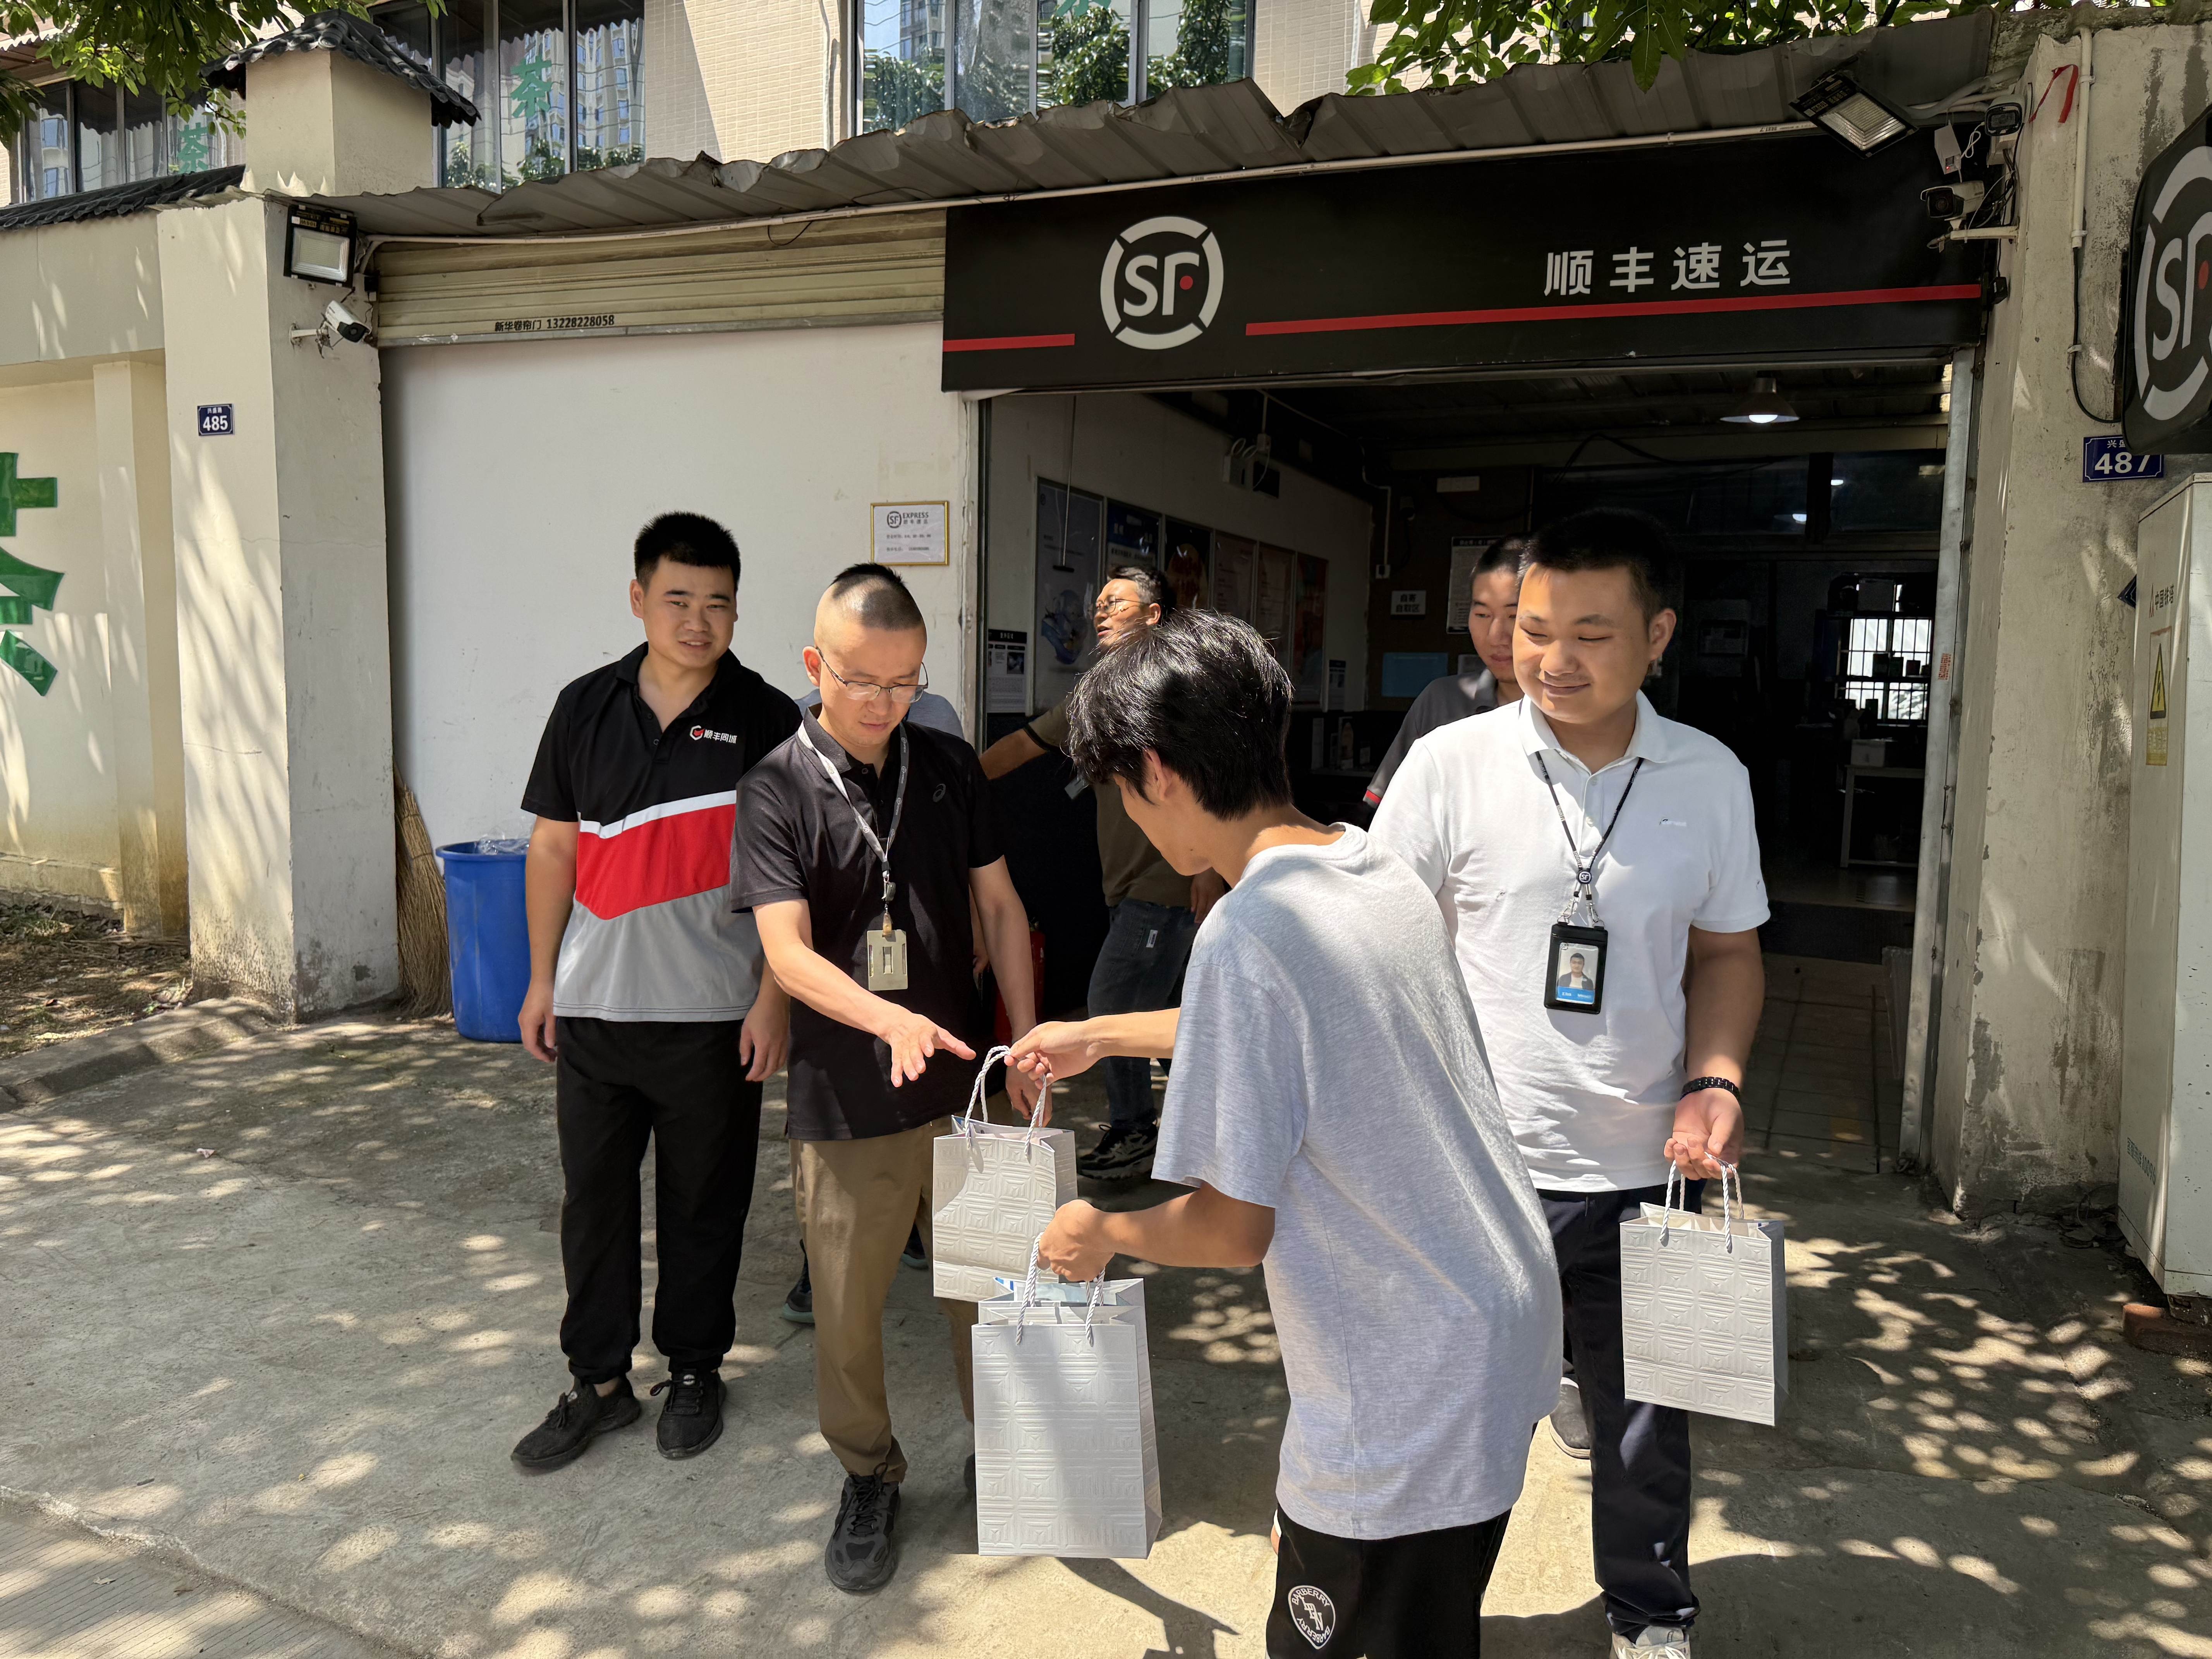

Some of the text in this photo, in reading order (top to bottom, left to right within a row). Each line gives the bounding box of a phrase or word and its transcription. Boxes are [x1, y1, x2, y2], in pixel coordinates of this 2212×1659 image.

[510, 55, 552, 118] 茶
[176, 122, 210, 174] 茶
[1544, 239, 1791, 297] 顺丰速运
[1123, 251, 1200, 317] SF
[495, 315, 614, 332] 新华卷帘门 13228228058
[203, 415, 228, 431] 485
[2095, 452, 2150, 474] 487
[2155, 584, 2174, 610] 中国铁塔
[704, 729, 737, 744] 顺丰同城
[1292, 1588, 1331, 1606] BARBERRY
